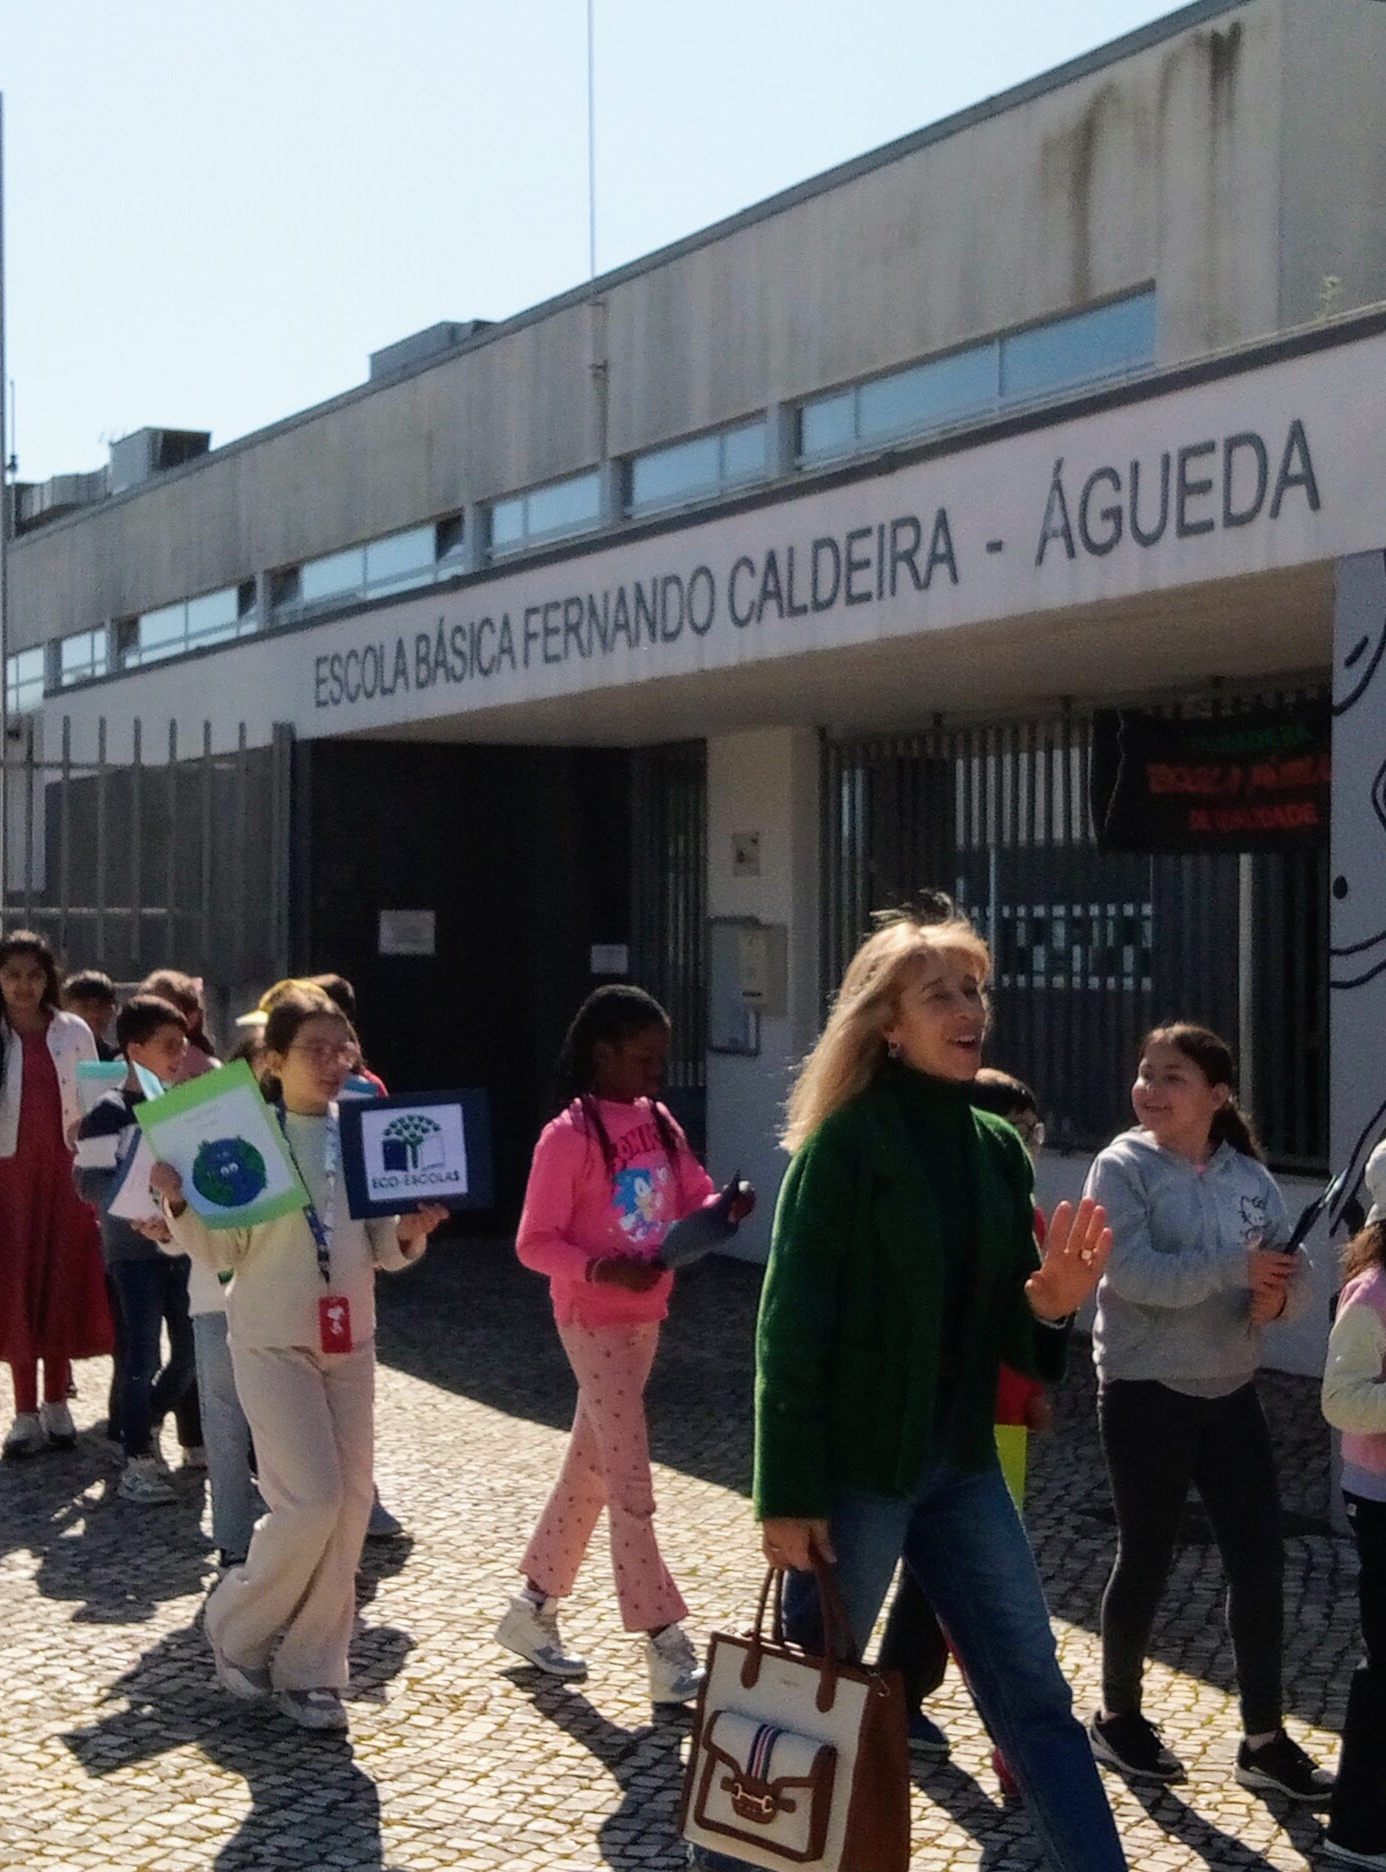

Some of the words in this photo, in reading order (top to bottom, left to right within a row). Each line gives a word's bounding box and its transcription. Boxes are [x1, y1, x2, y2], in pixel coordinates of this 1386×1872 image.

[314, 635, 410, 708] ESCOLA
[415, 615, 517, 689] BÁSICA
[524, 565, 715, 669] FERNANDO
[727, 506, 959, 628] CALDEIRA
[1034, 418, 1320, 567] ÁGUEDA
